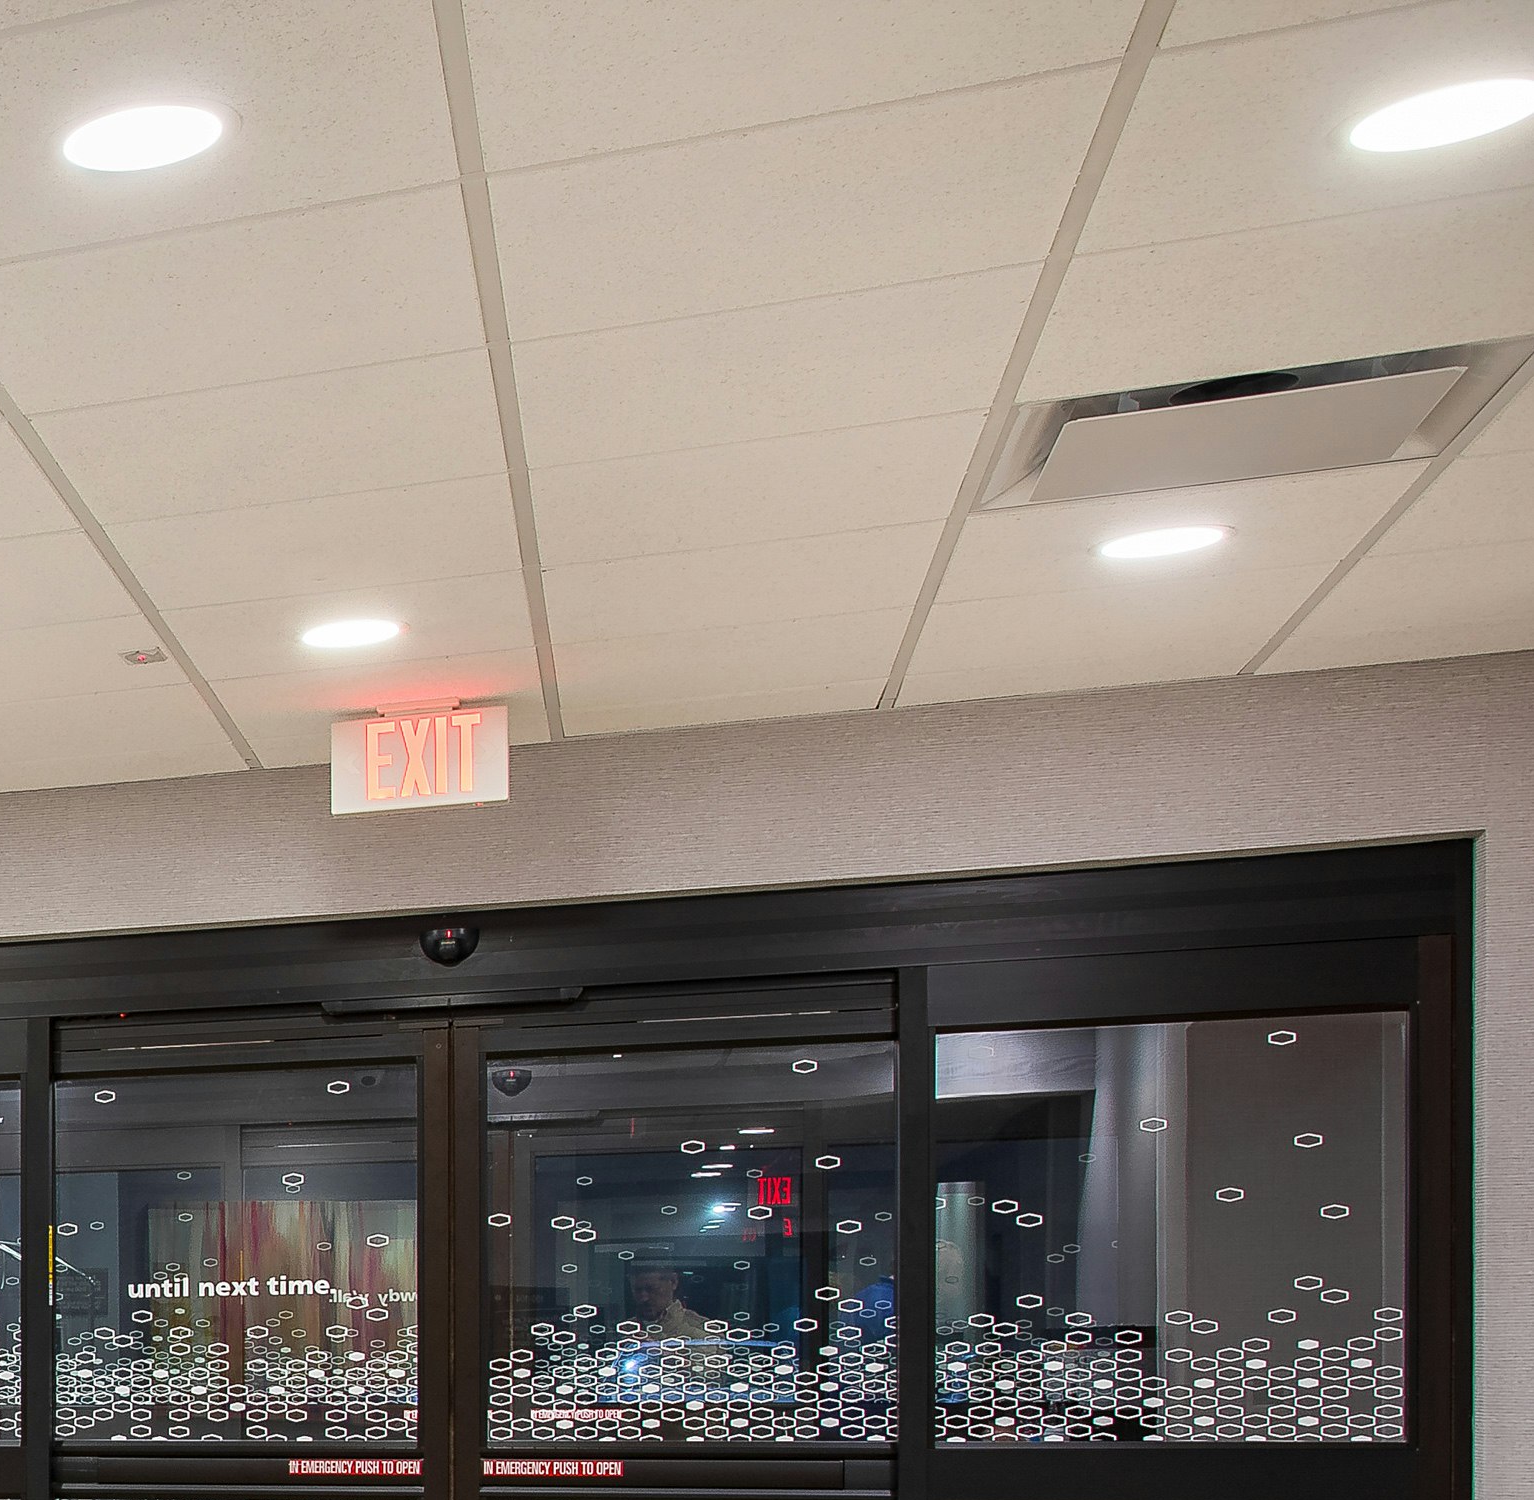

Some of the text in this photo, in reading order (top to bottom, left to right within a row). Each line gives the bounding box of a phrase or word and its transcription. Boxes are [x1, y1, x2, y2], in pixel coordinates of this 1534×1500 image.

[365, 712, 481, 801] EXIT
[127, 1278, 190, 1299] until
[198, 1278, 260, 1298] next
[289, 1460, 420, 1474] IN EMERGENCY PUSH TO OPEN
[484, 1461, 622, 1475] IN EMERGENCY PUSH TO OPEN
